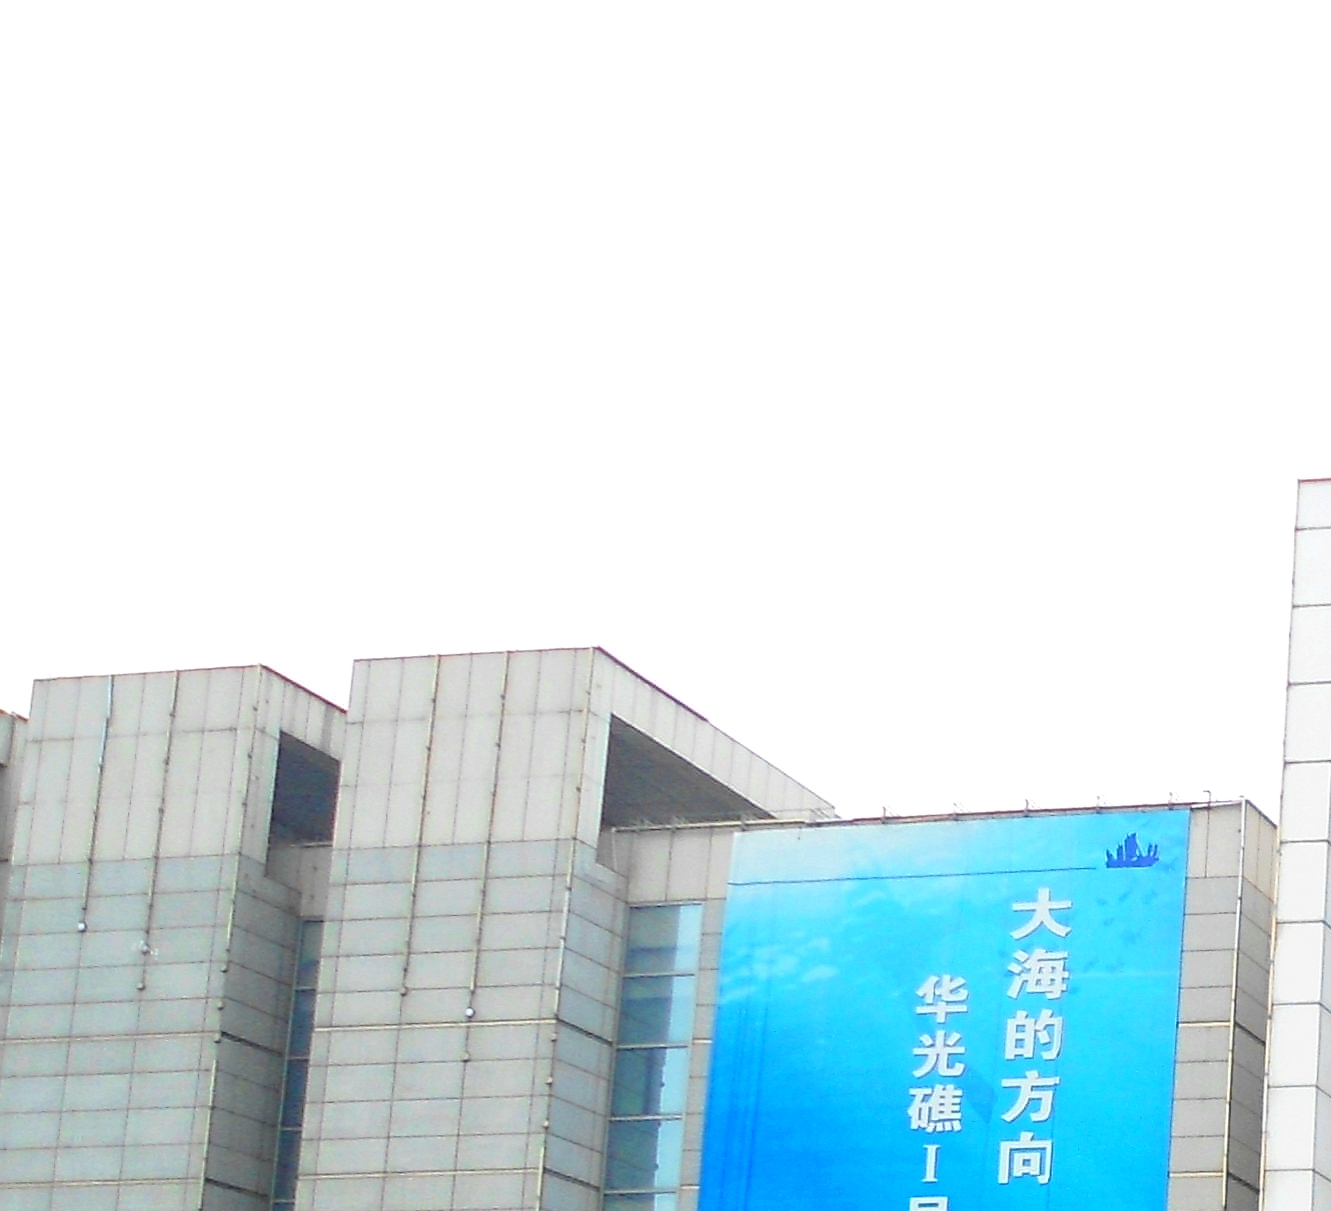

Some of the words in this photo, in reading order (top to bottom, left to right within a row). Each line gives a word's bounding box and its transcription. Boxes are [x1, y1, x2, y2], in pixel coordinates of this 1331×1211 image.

[998, 886, 1073, 1186] 大海的方向
